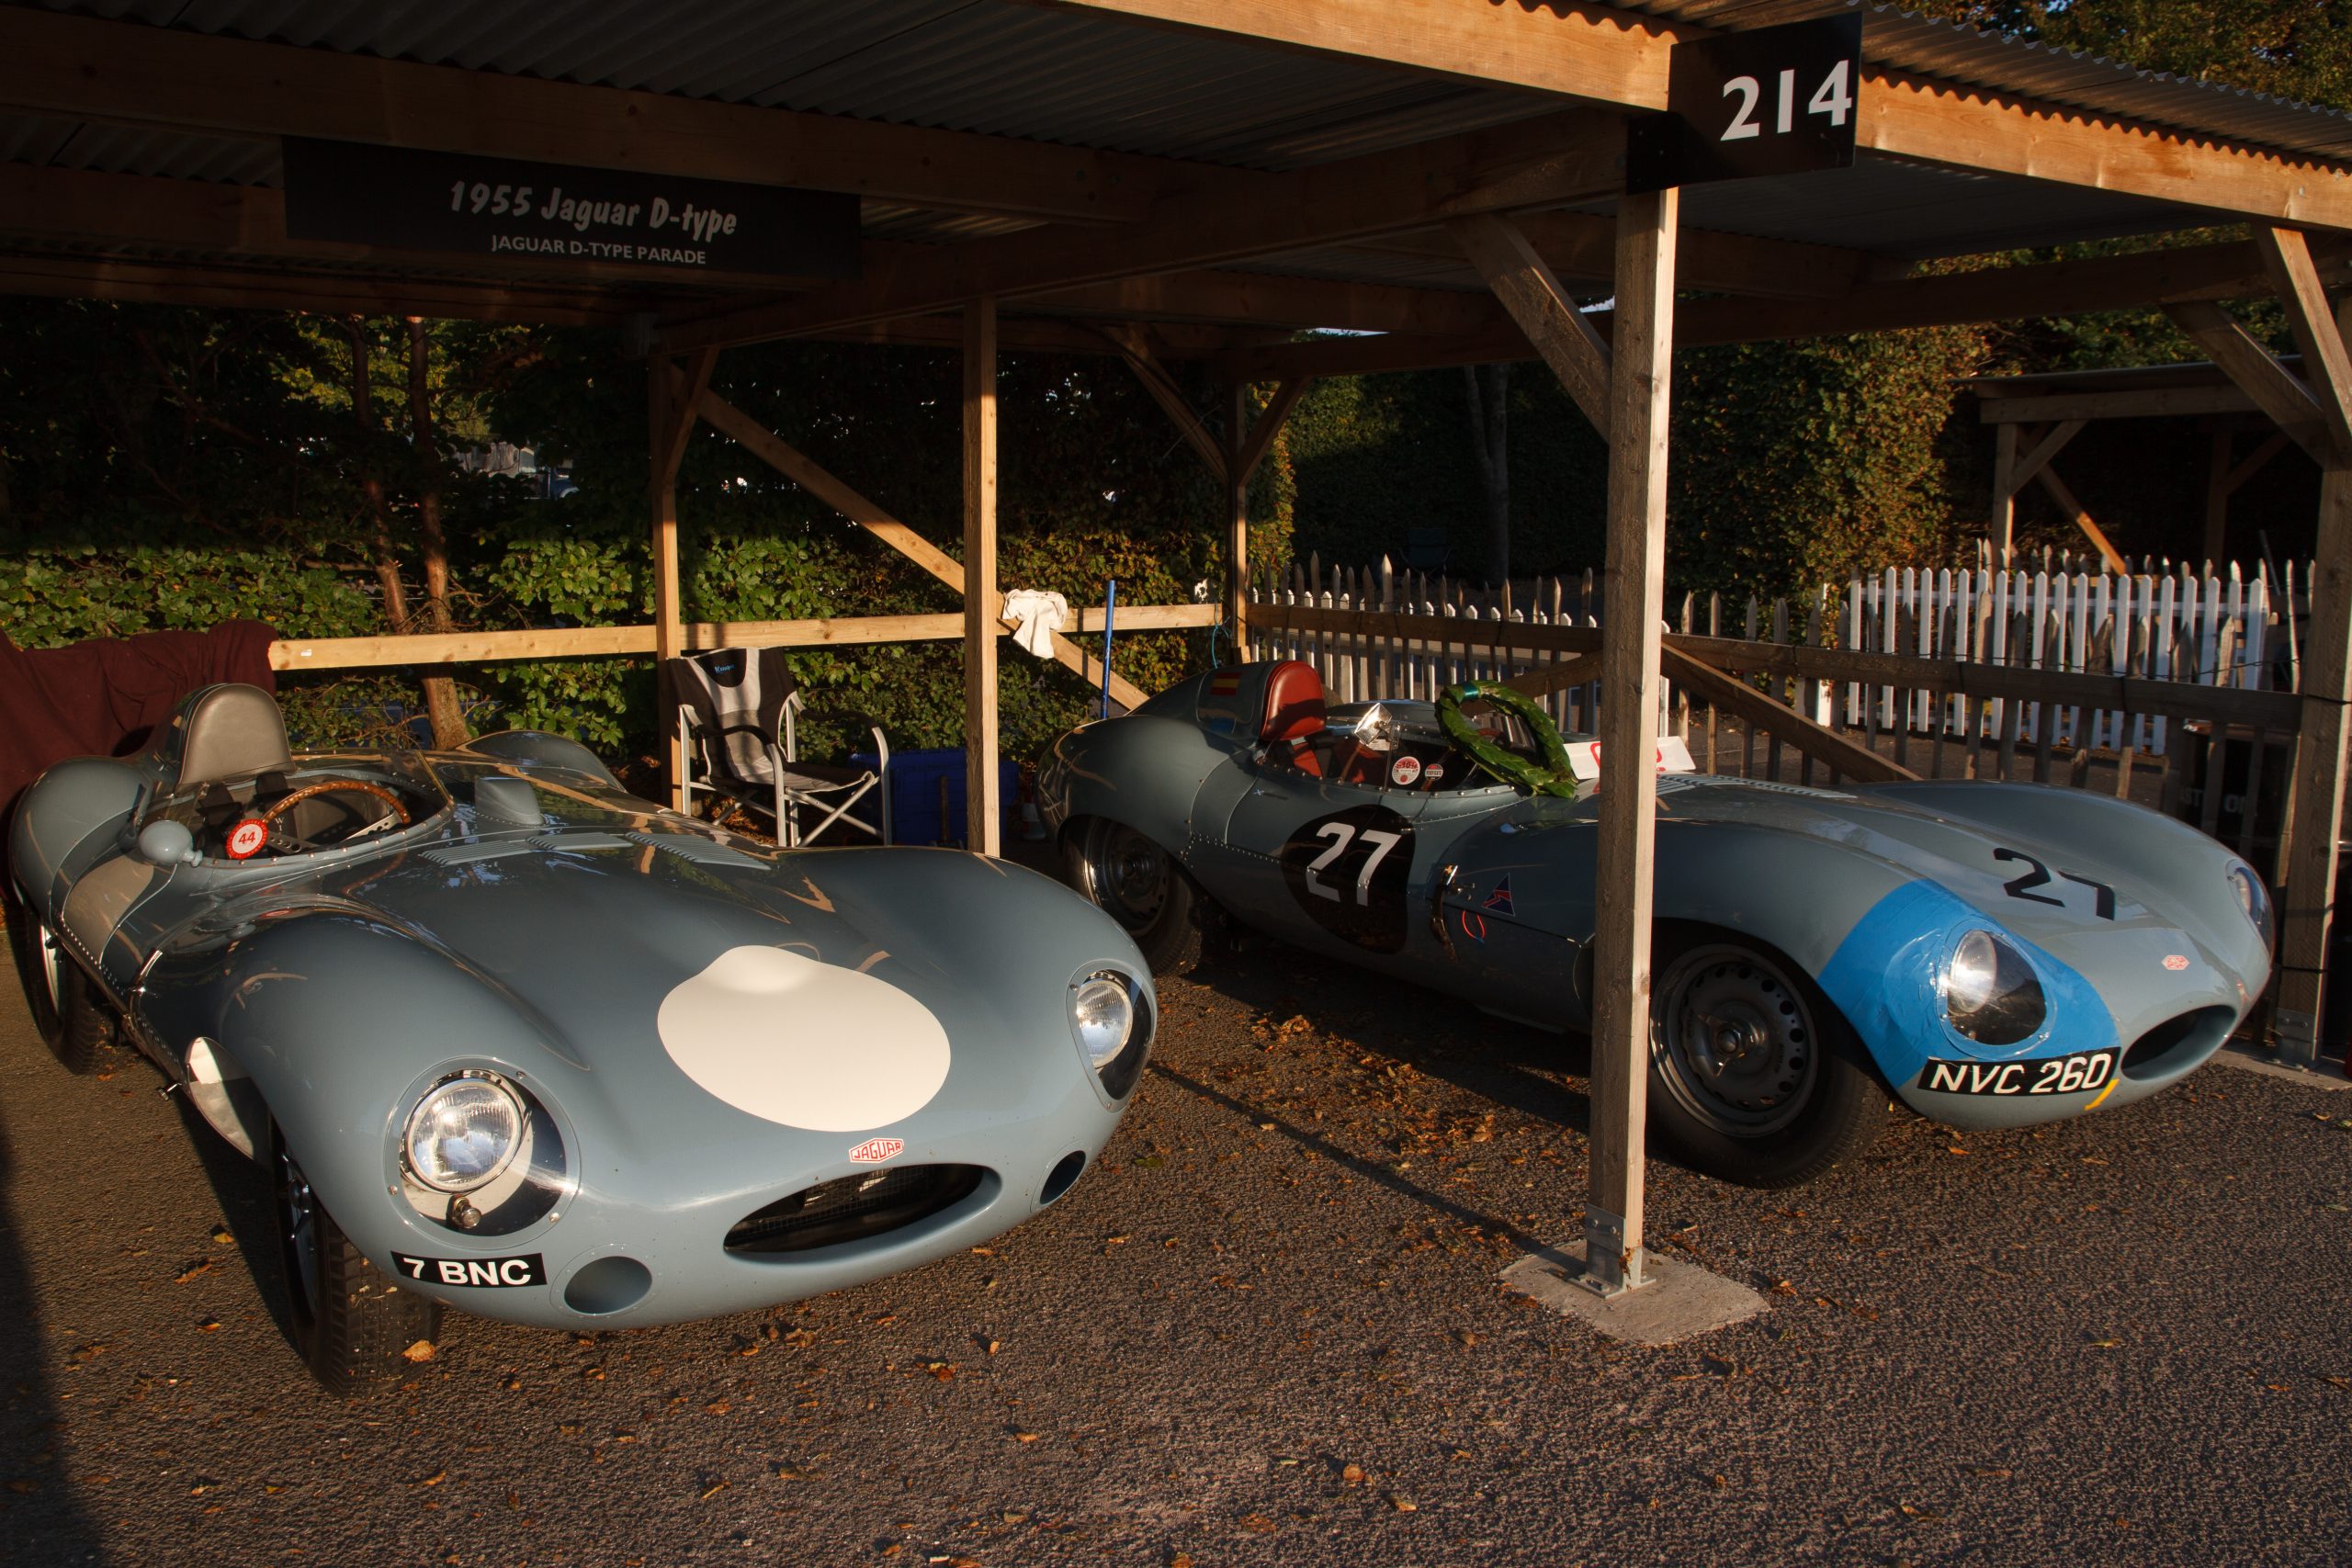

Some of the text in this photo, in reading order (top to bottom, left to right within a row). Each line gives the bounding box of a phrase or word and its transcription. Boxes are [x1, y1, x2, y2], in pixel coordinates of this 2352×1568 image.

[1720, 59, 1852, 141] 214
[450, 180, 738, 243] 1955 Jaguar D-type
[491, 234, 707, 265] JAGUAR D-TYPE PARADE
[238, 830, 256, 844] 44
[1305, 821, 1403, 907] 27
[1993, 847, 2116, 921] 27
[1929, 1053, 2112, 1094] NVC 260
[853, 1141, 902, 1160] JAGUAR
[402, 1257, 532, 1286] 7 BNC
